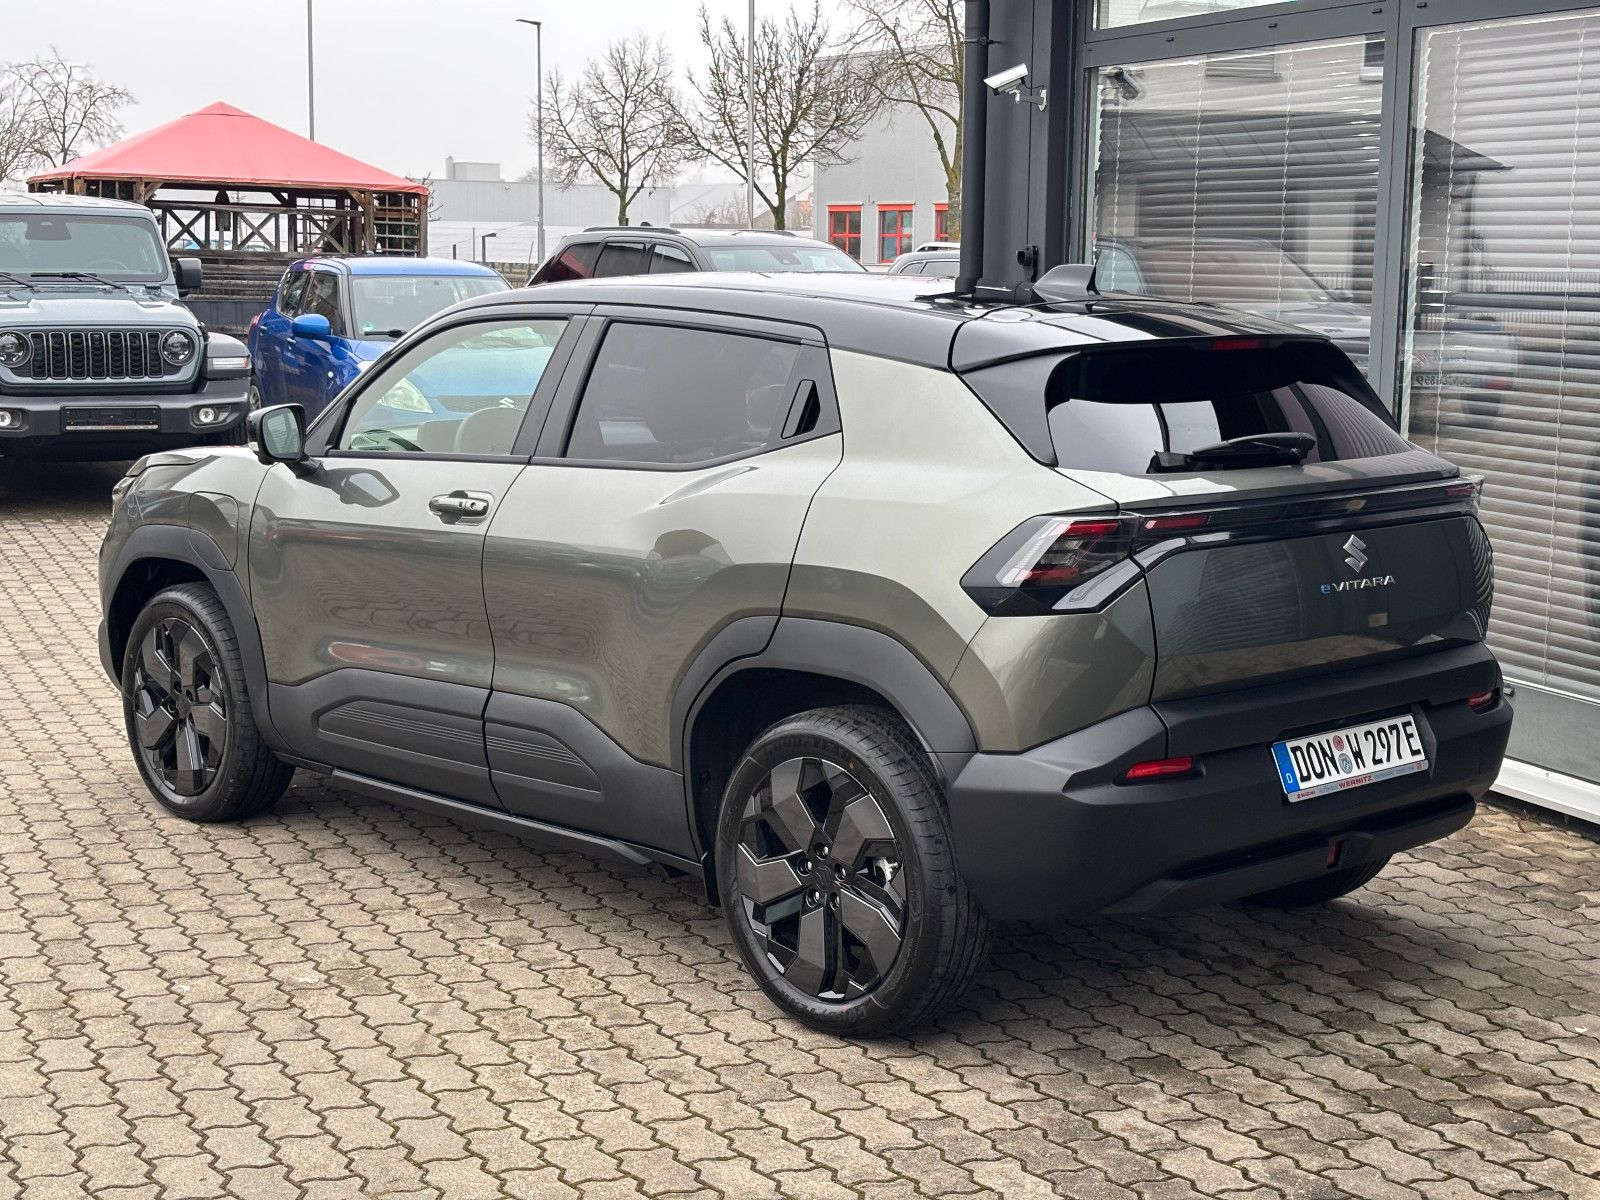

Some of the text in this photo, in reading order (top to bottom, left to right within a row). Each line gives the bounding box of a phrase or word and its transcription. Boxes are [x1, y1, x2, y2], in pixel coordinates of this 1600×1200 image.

[1290, 738, 1340, 782] DON
[1345, 732, 1366, 770] W
[1363, 720, 1422, 766] 297E
[1285, 773, 1293, 784] D
[1338, 775, 1373, 789] WERNITZ
